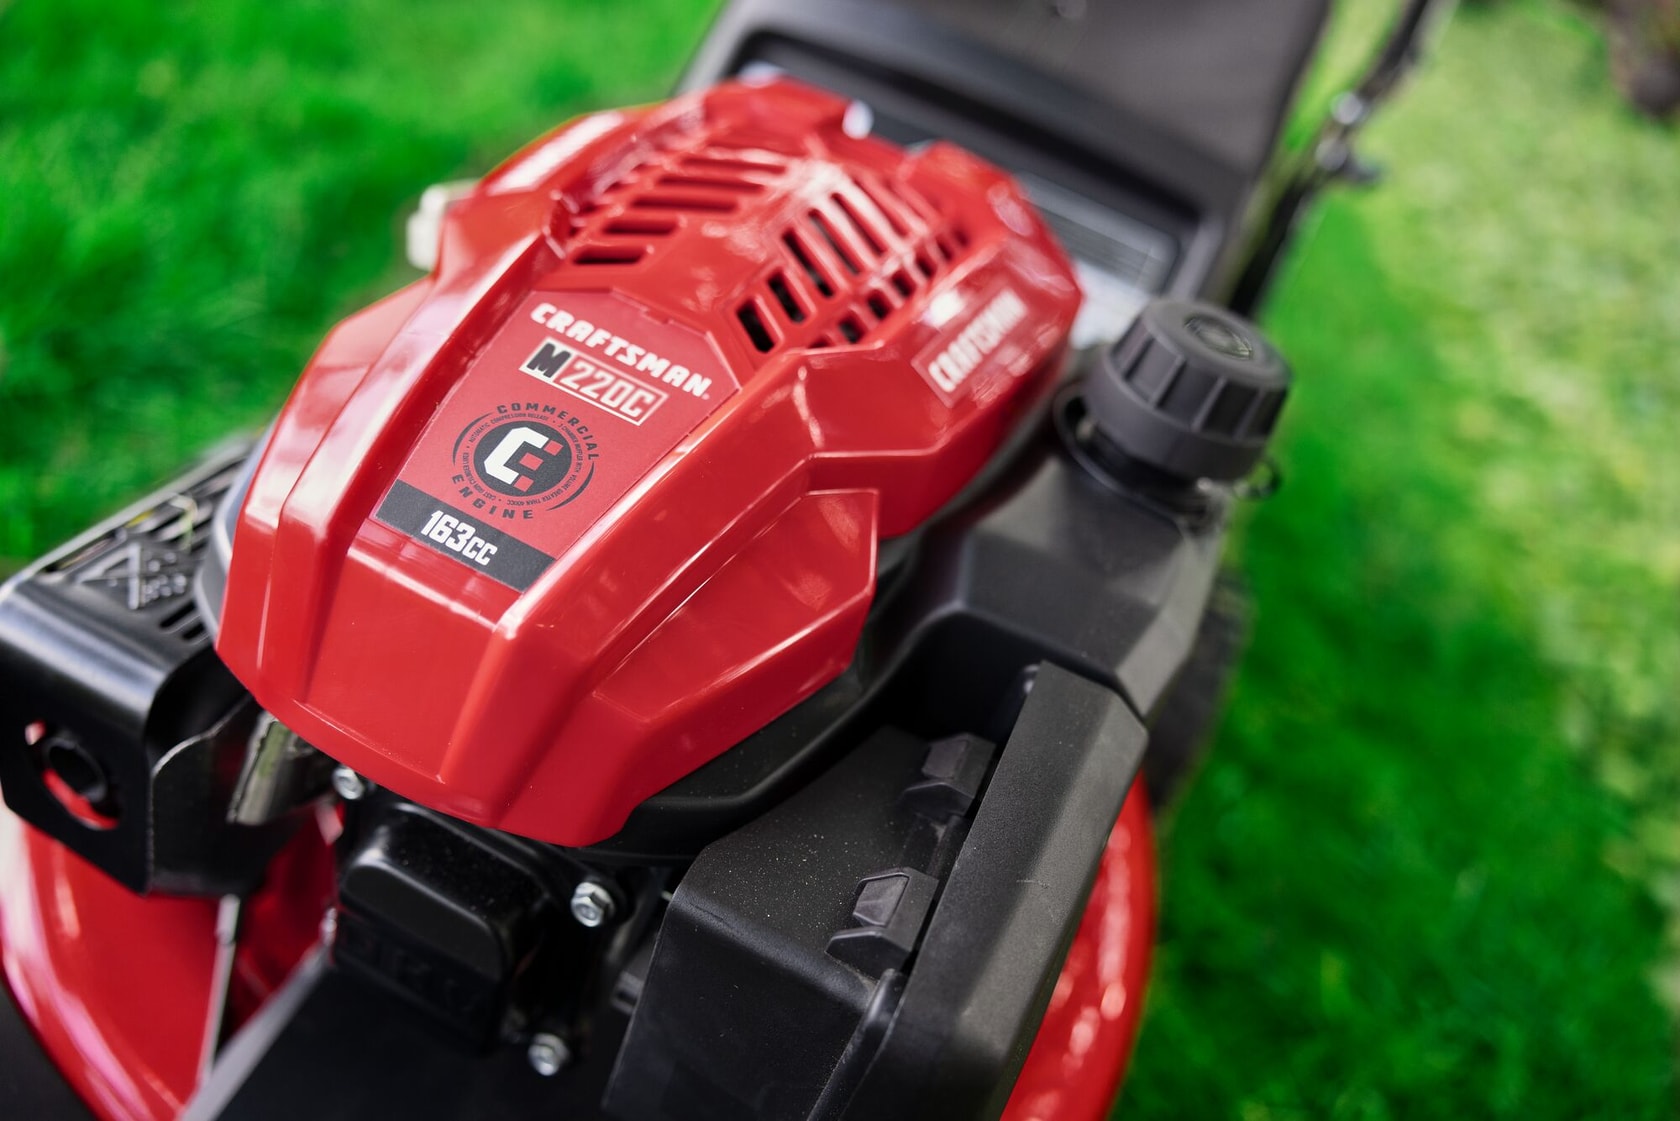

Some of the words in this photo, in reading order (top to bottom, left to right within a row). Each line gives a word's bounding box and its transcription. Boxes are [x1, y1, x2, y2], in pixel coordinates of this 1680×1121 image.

[530, 303, 712, 398] CRAFTSMAN
[497, 402, 599, 460] COMMERCIAL
[452, 473, 534, 519] ENGINE
[420, 510, 498, 566] 163CC
